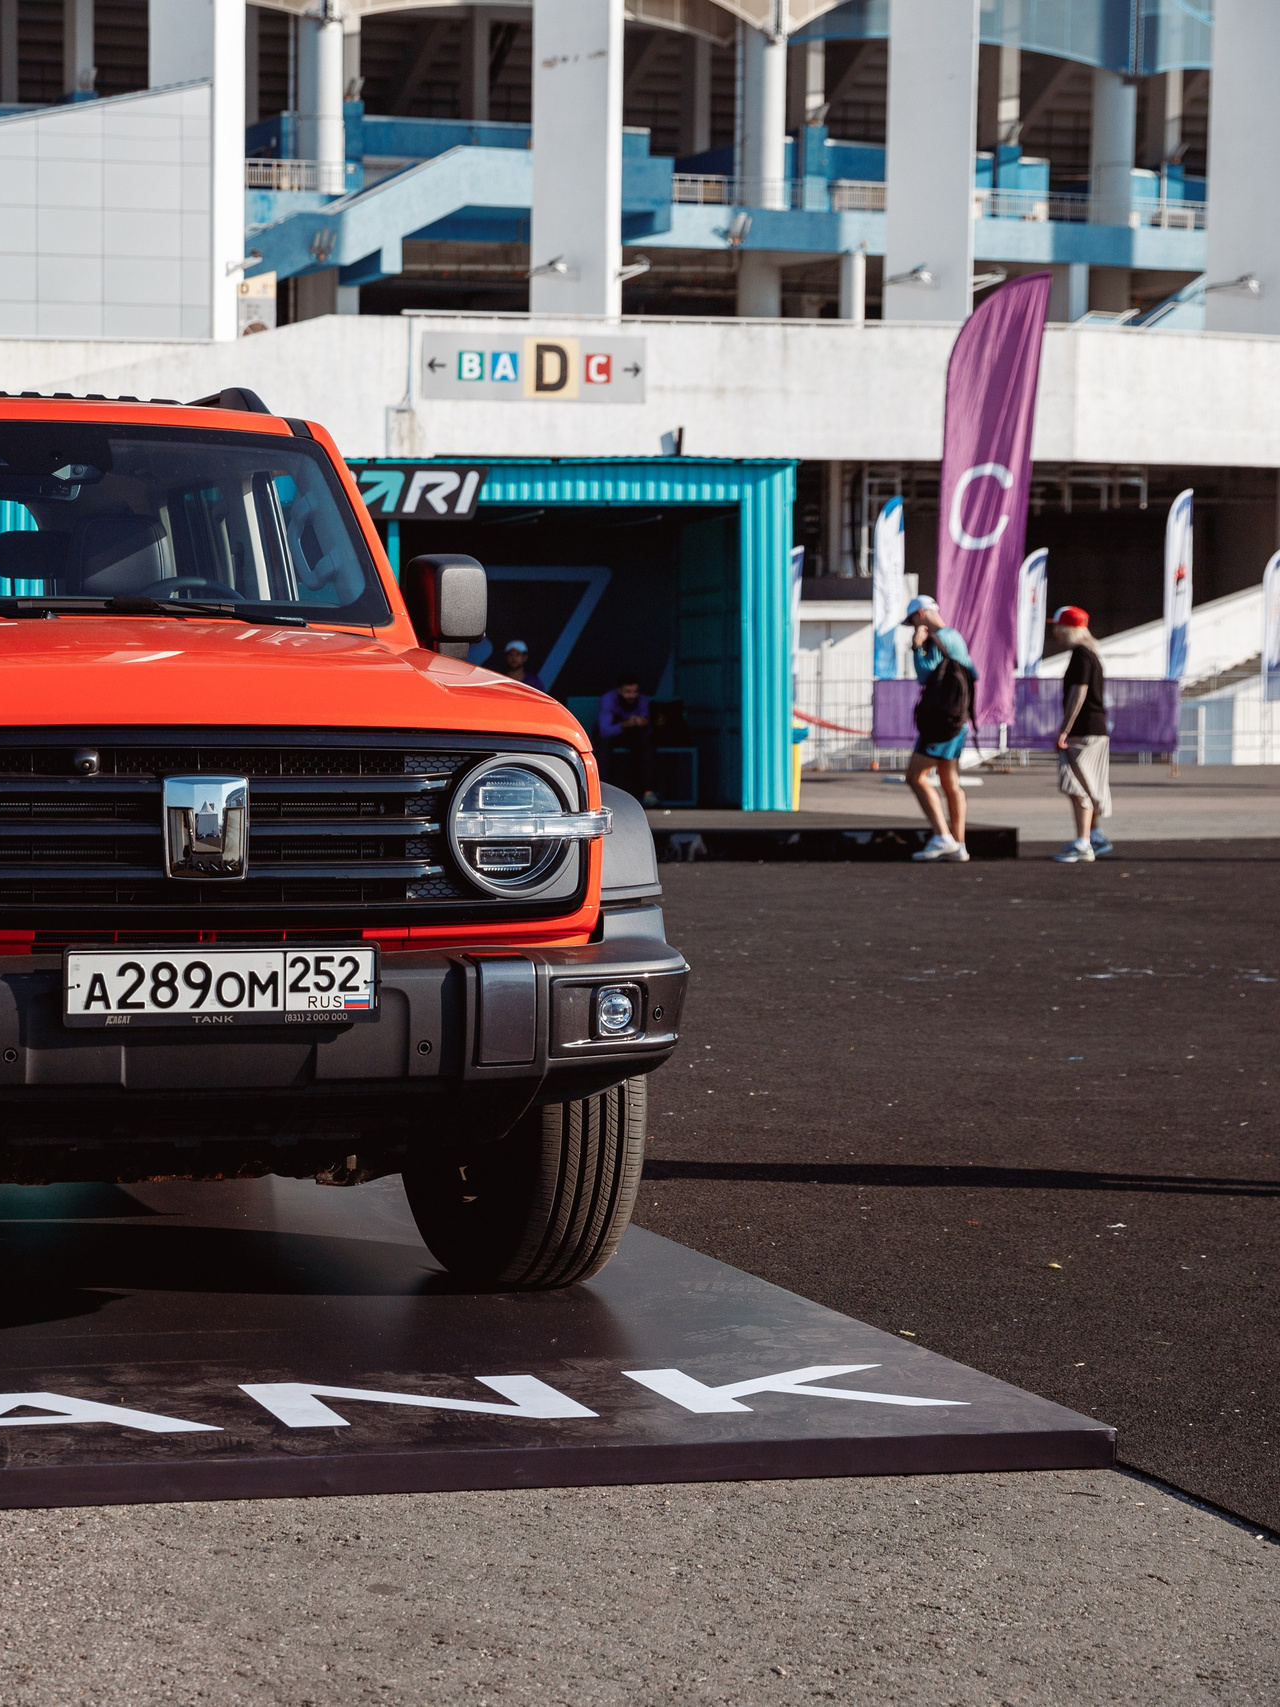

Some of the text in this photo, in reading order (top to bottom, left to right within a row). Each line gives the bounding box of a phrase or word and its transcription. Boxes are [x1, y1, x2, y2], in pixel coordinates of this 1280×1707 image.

[460, 343, 608, 392] B A D C
[349, 470, 480, 515] ARI
[288, 955, 361, 993] 252
[307, 995, 342, 1009] RUS
[191, 1015, 234, 1023] TANK
[284, 1012, 348, 1023] (831) 2 000 000
